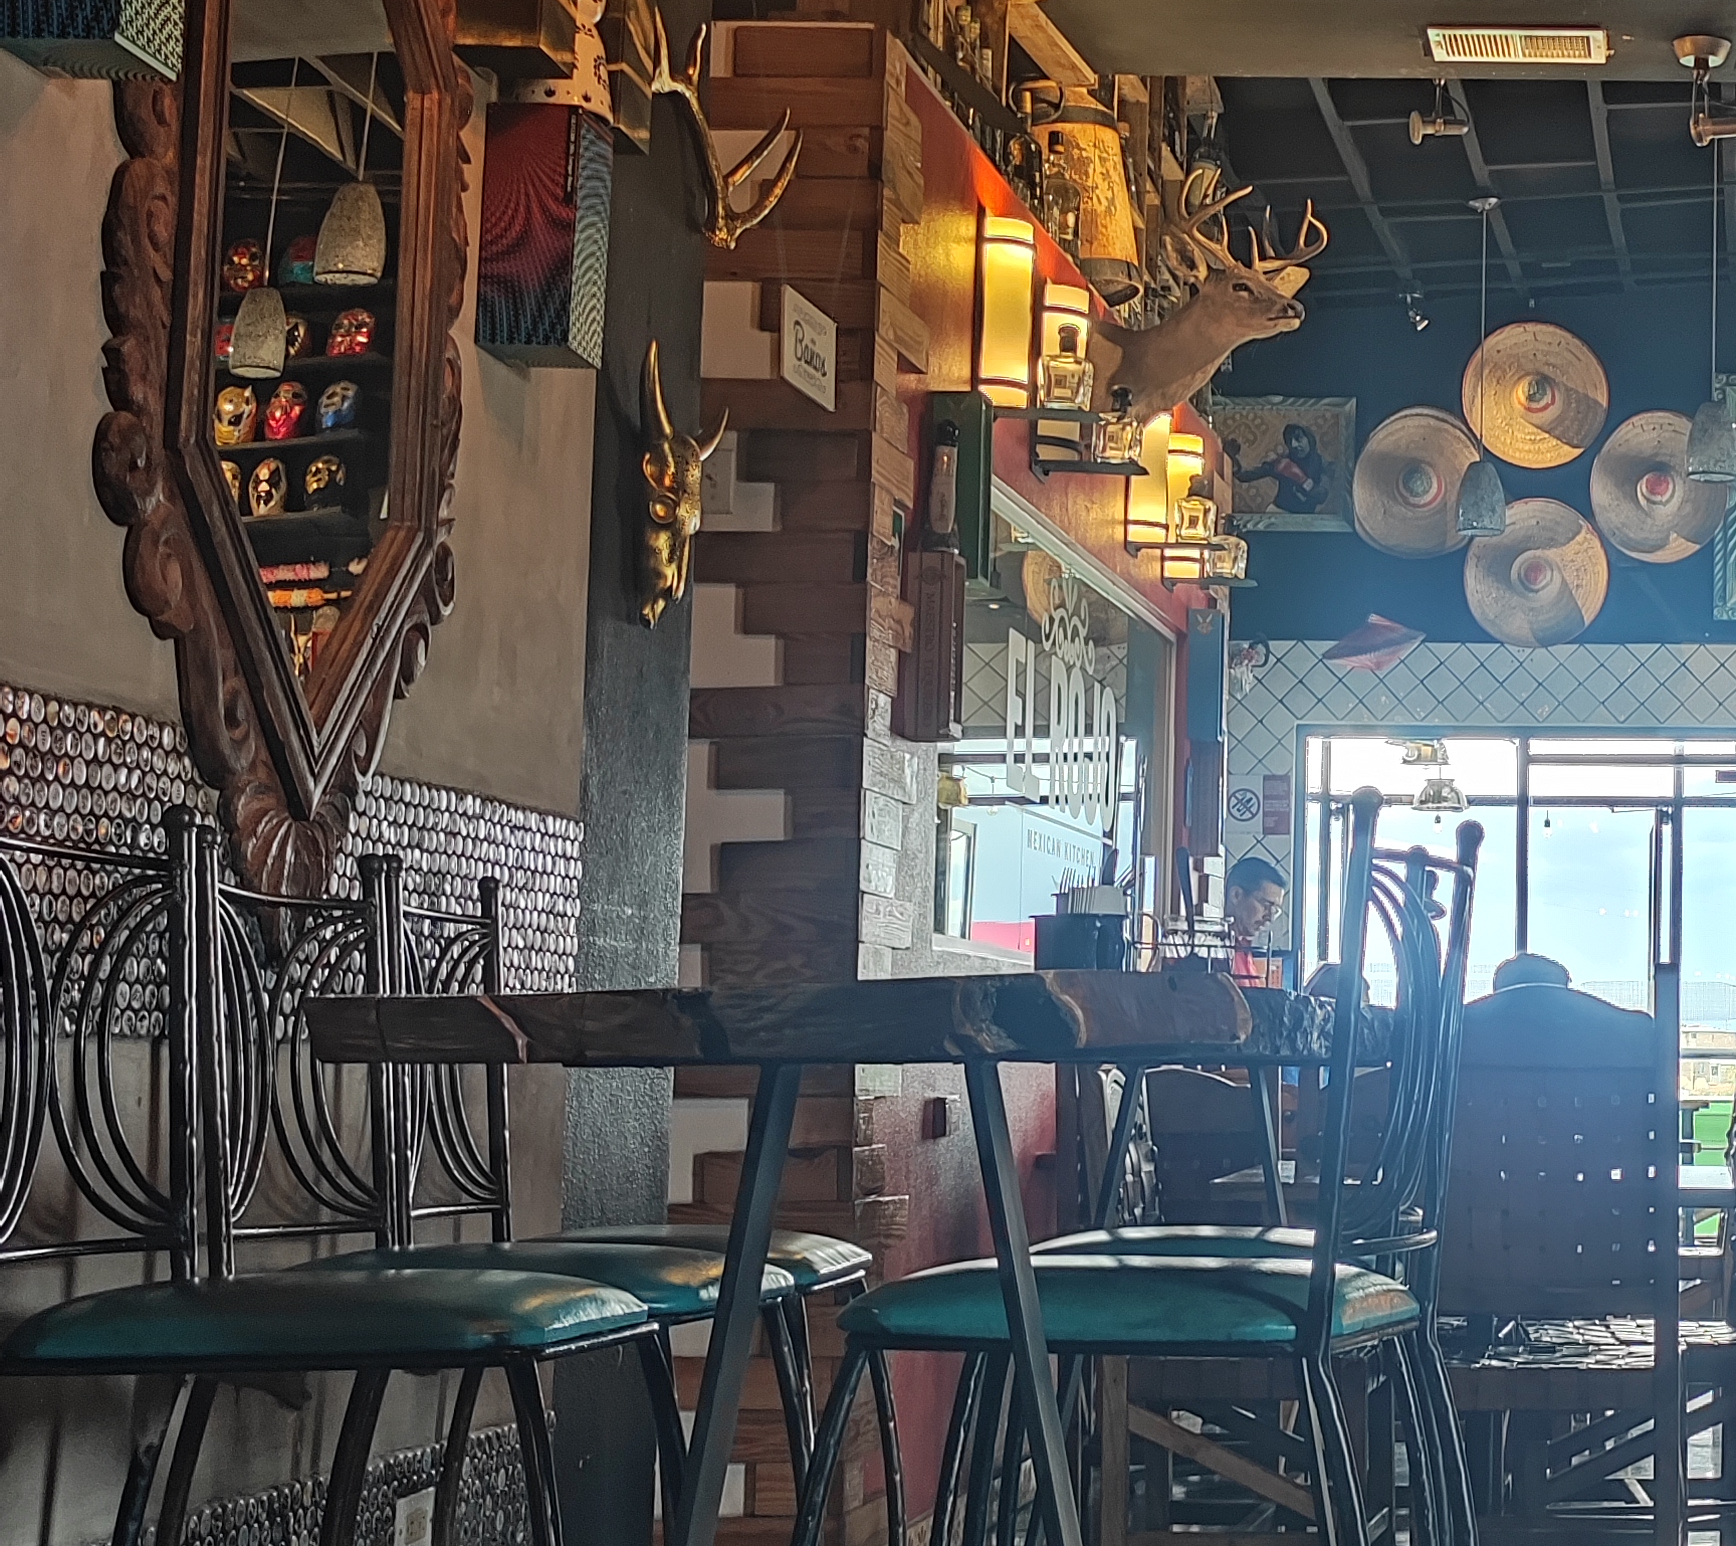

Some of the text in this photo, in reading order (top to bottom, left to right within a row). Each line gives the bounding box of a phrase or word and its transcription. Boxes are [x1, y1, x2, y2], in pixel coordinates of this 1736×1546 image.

[1007, 628, 1116, 832] EL ROJO
[1027, 829, 1094, 867] MEXICAN KITCHEN
